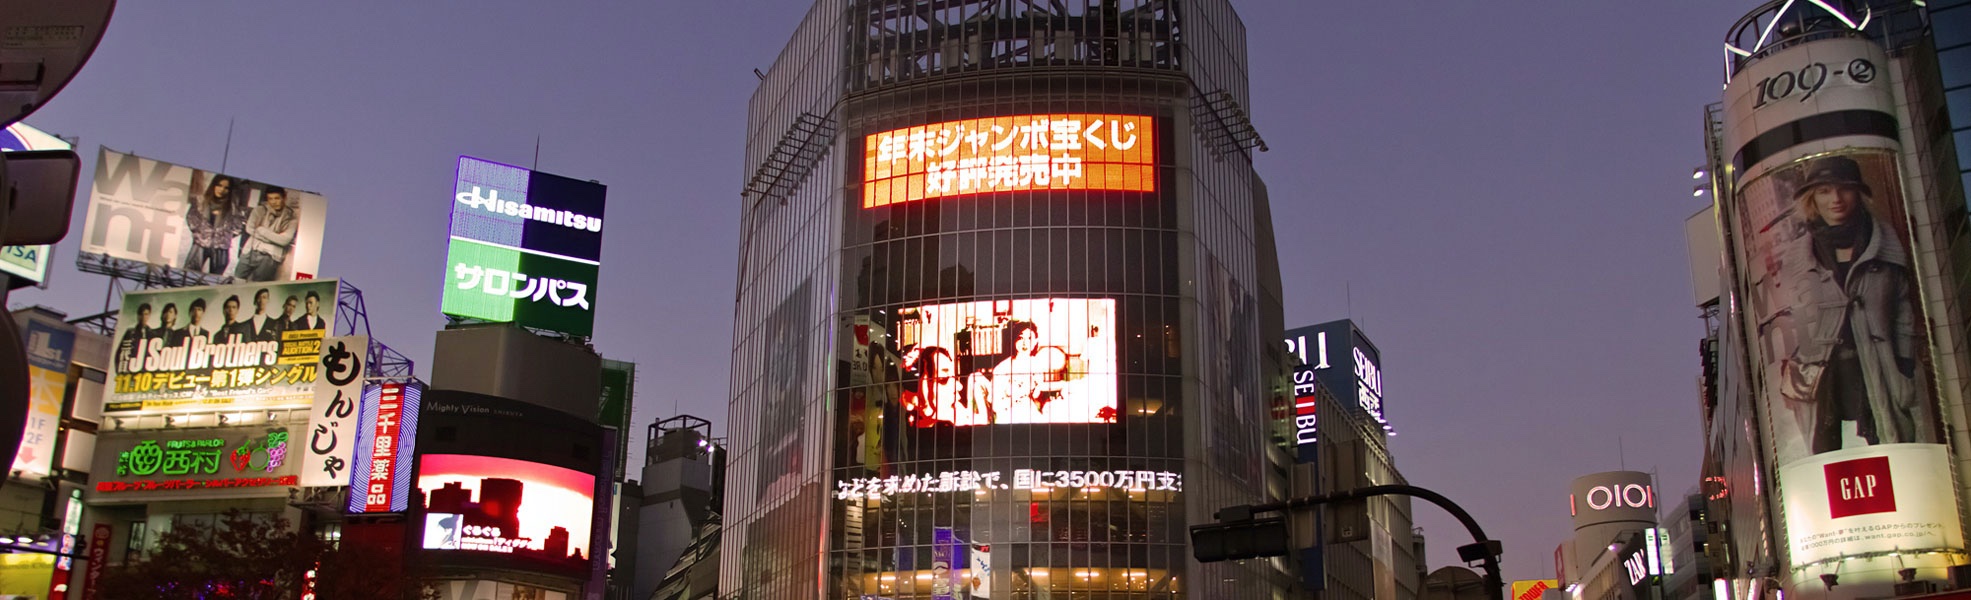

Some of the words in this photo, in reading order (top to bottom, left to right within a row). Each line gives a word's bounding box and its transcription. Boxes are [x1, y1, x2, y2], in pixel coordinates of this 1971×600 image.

[877, 118, 1138, 165] 年末ジャンボ宝くじ
[926, 153, 1083, 194] 好評発売中
[456, 186, 602, 233] Hisamitsu
[454, 262, 589, 311] サロンパス
[129, 339, 147, 372] J
[147, 335, 191, 371] Soul
[191, 331, 279, 370] Brothers
[30, 417, 45, 429] 1F
[311, 341, 361, 479] もんじゃ
[461, 404, 490, 415] Vision
[1294, 370, 1317, 444] SEIBU
[27, 431, 43, 444] 2F
[366, 386, 402, 506] 三千里薬品
[163, 449, 221, 475] 西村
[1840, 474, 1877, 501] GAP
